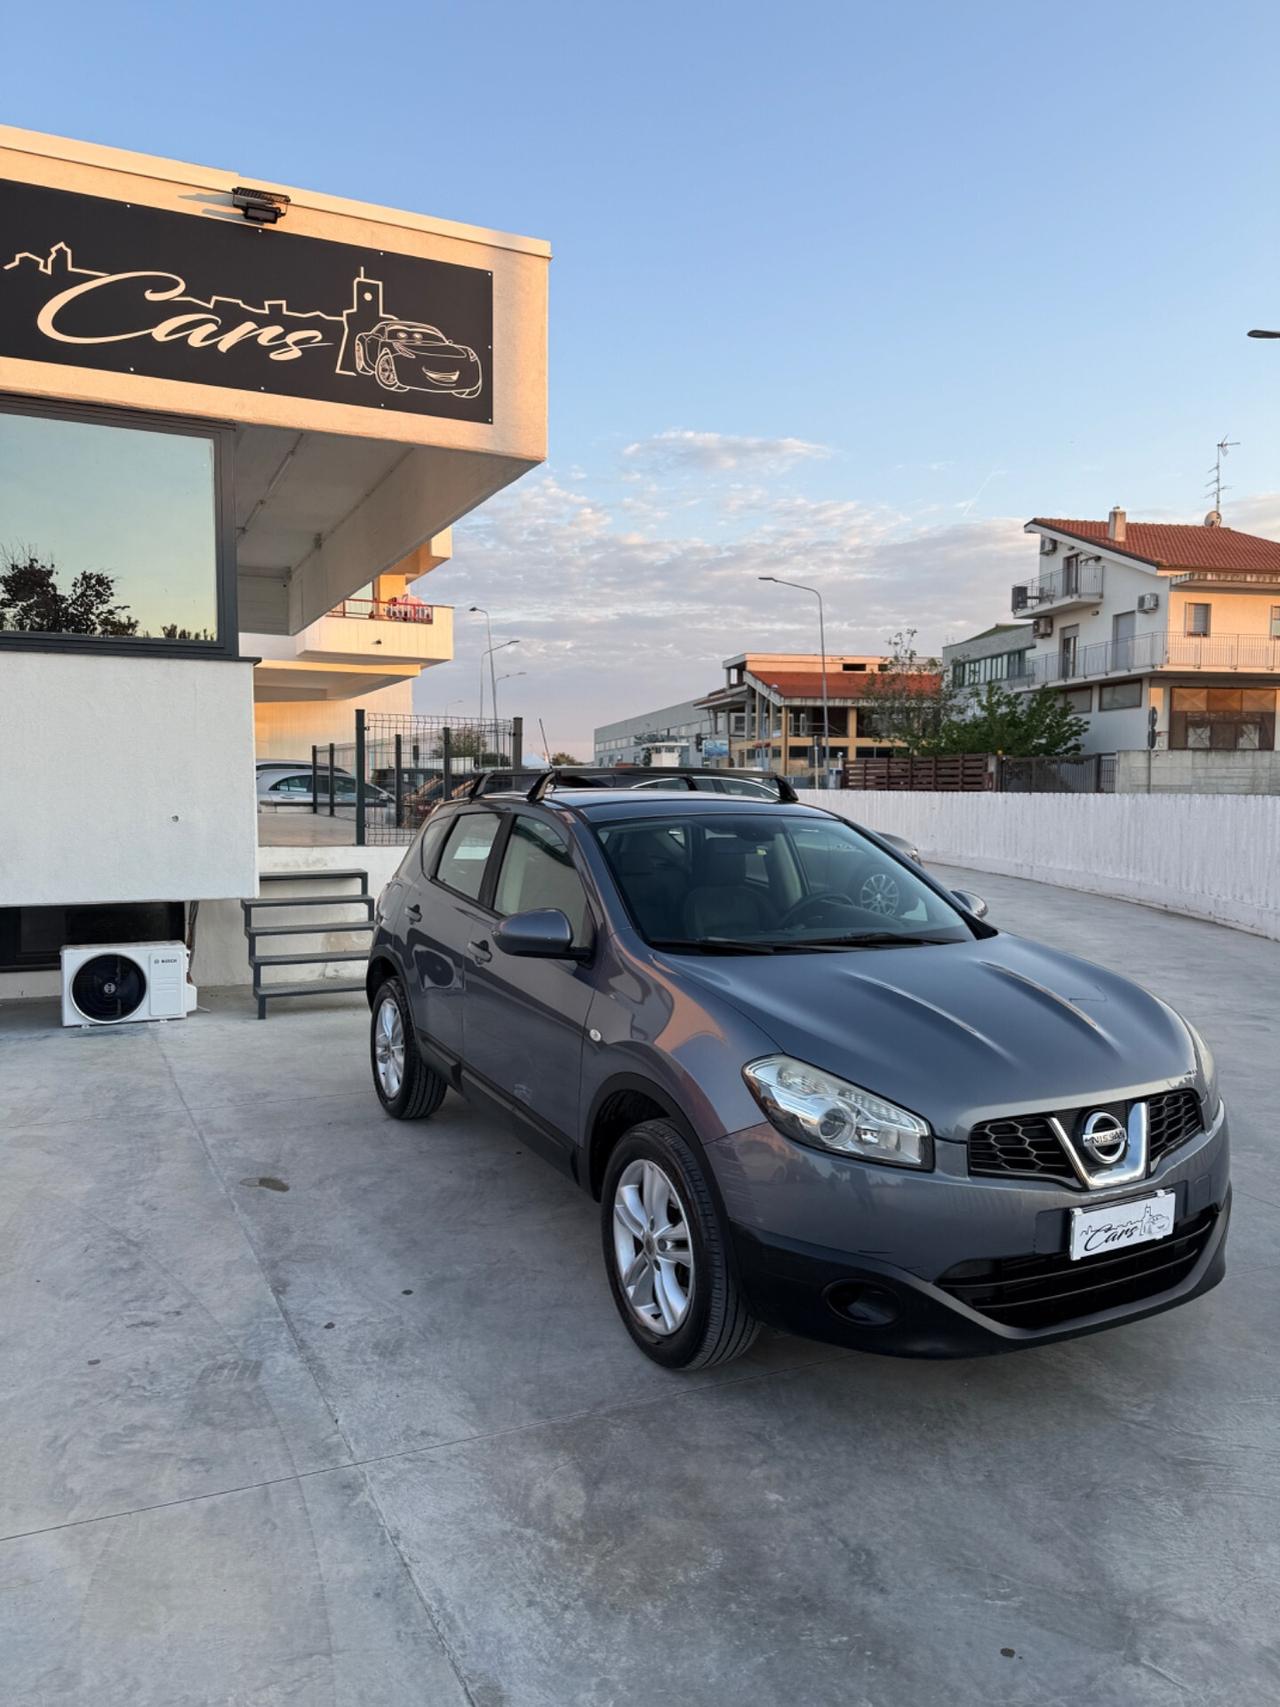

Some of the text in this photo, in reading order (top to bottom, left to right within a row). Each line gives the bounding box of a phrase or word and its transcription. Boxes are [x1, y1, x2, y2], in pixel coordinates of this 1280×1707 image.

[37, 271, 334, 361] Cars
[1090, 1130, 1125, 1144] NISSAN
[1084, 1224, 1138, 1251] Cars
